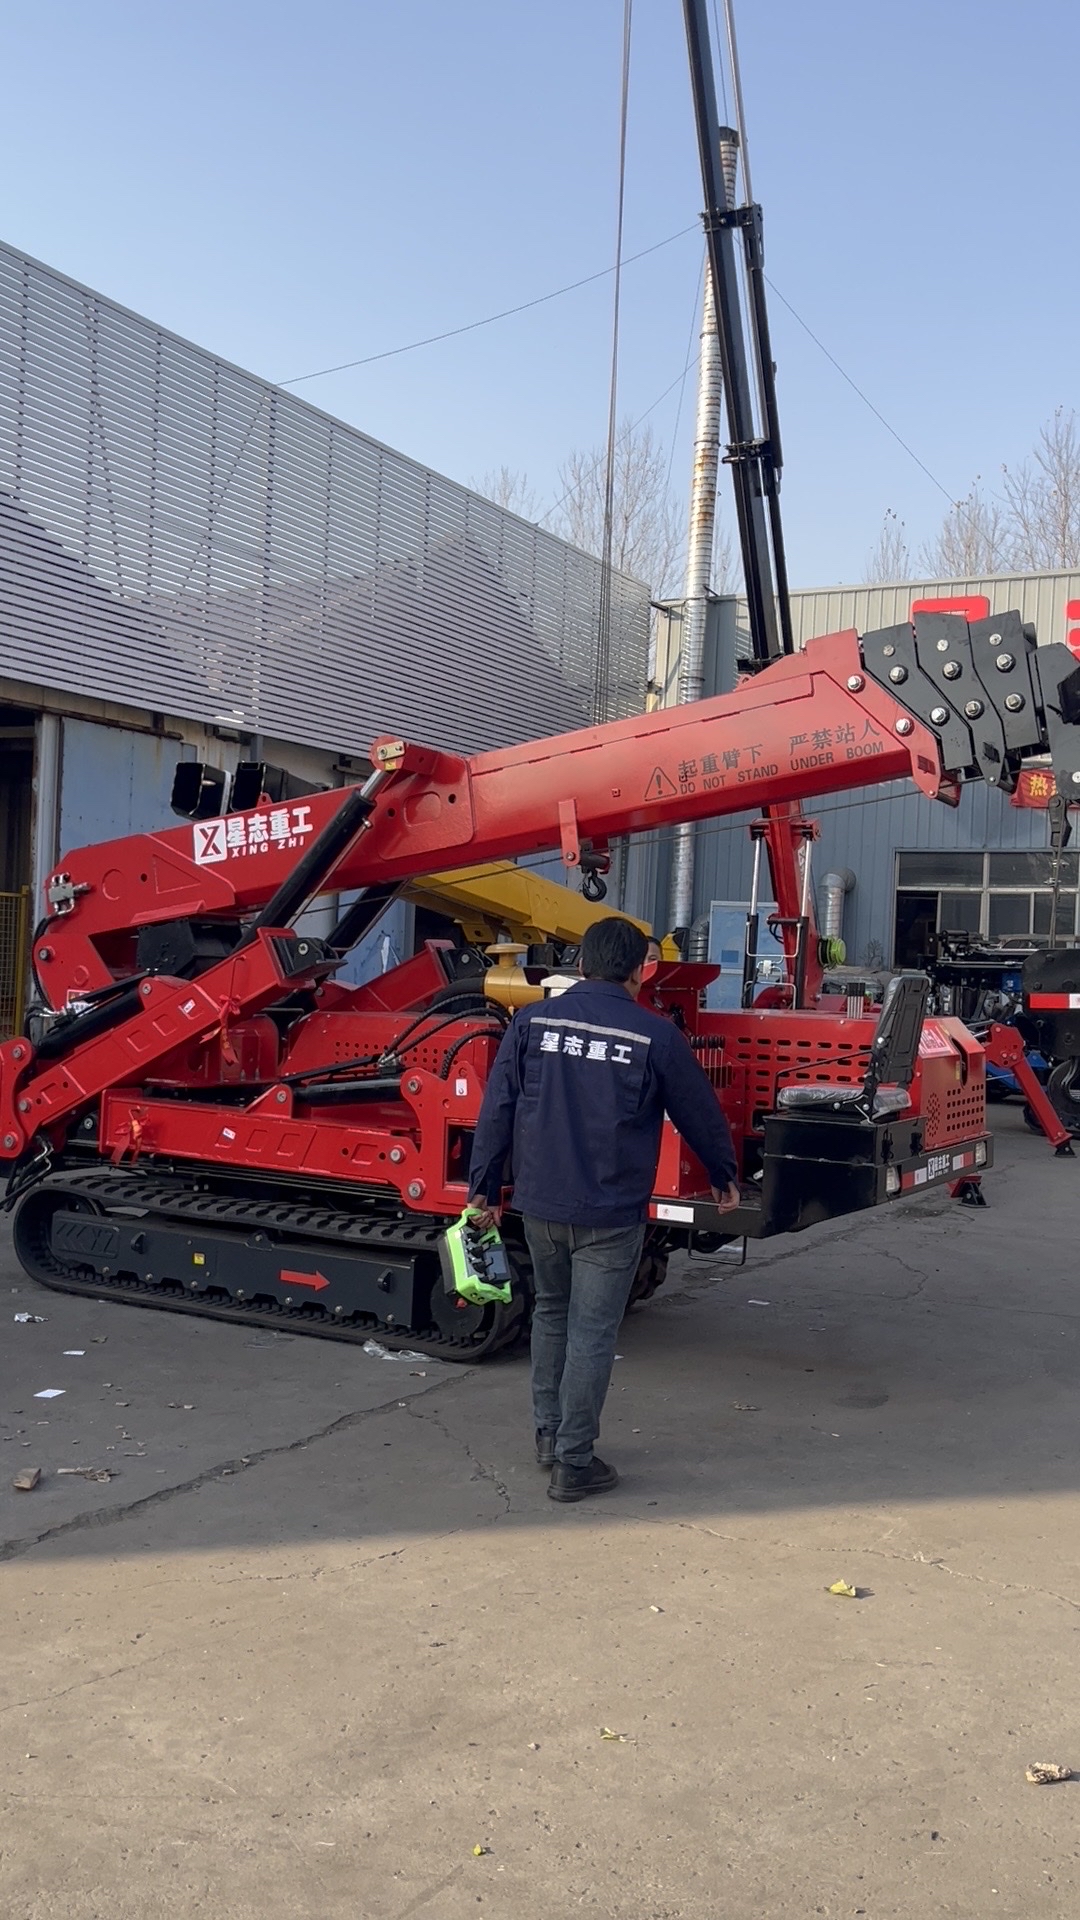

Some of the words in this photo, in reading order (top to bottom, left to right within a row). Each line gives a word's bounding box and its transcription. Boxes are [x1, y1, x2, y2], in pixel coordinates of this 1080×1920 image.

[678, 743, 763, 779] 起重臂下
[789, 718, 880, 755] 严禁站人
[680, 781, 696, 795] DO
[703, 775, 726, 790] NOT
[738, 764, 778, 783] STAND
[790, 751, 834, 771] UNDER
[846, 741, 884, 759] BOOM
[227, 805, 313, 848] 星志重工
[232, 843, 268, 858] XING
[278, 836, 304, 849] ZHI
[540, 1031, 632, 1064] 星志重工
